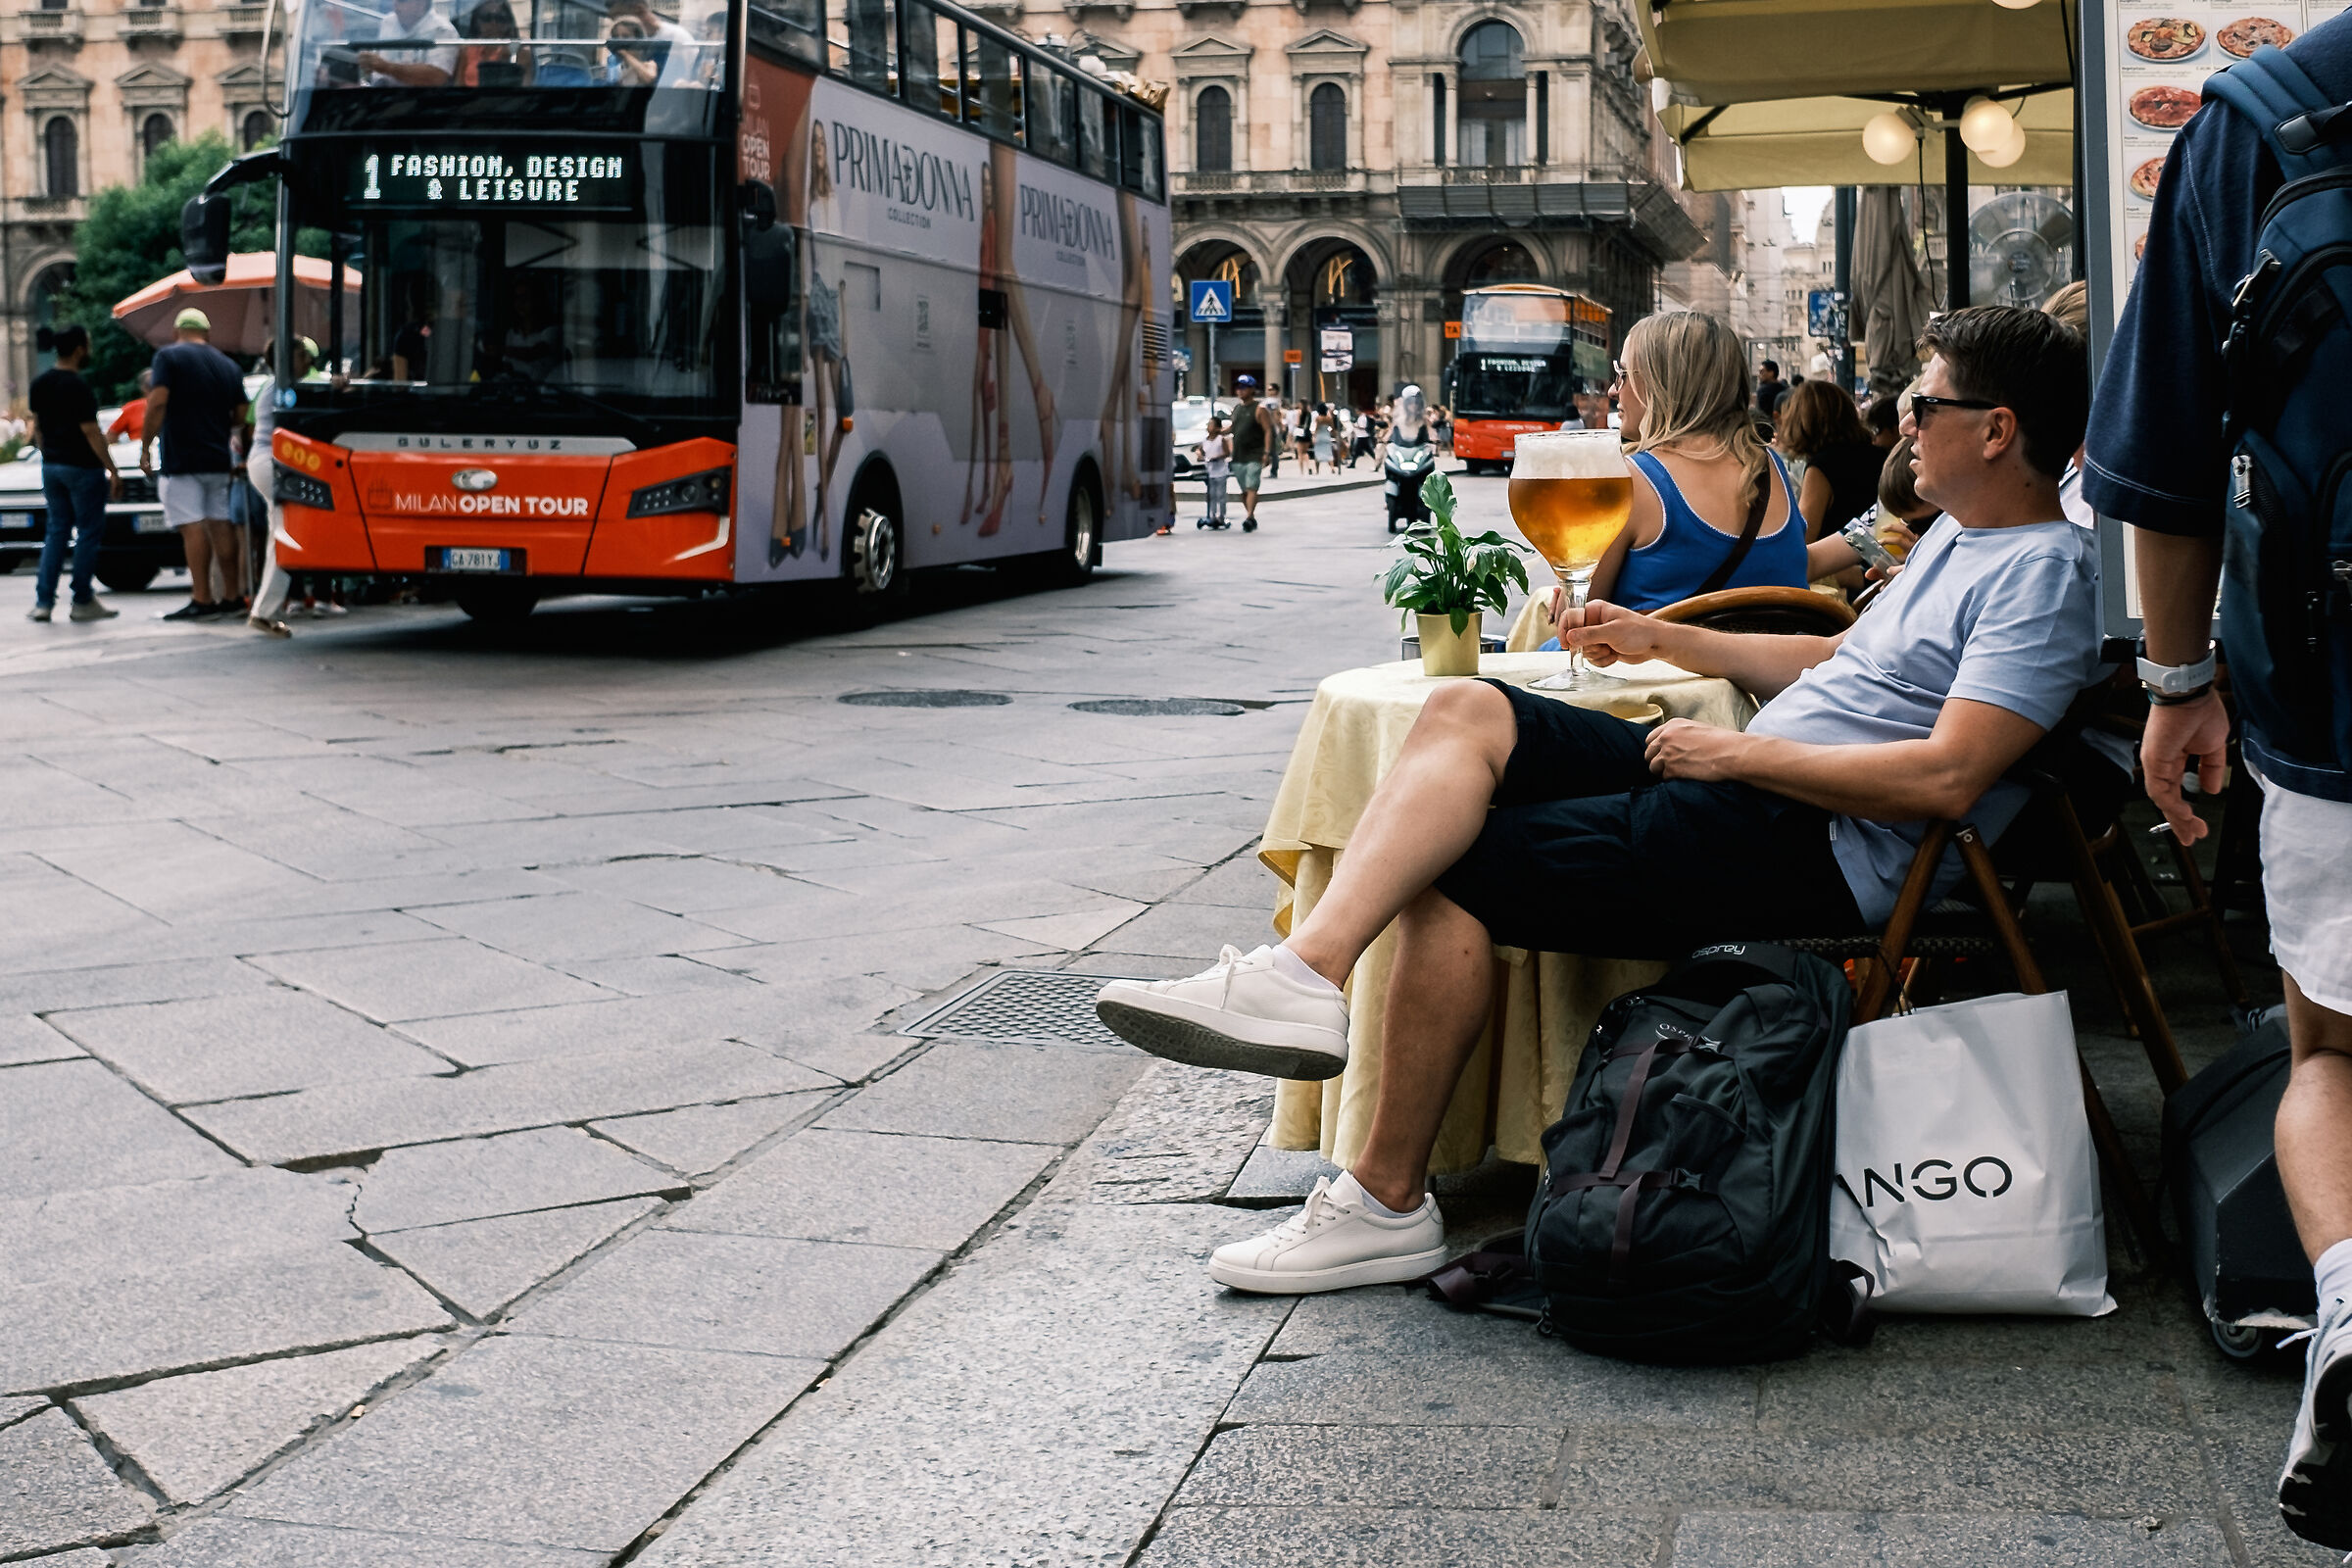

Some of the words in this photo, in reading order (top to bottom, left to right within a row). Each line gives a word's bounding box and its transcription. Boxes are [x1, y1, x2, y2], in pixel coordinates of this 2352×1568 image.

[742, 133, 770, 160] OPEN
[364, 154, 381, 199] 1
[391, 154, 514, 176] FASHION,
[526, 155, 622, 178] DESIGN
[742, 156, 770, 179] TOUR
[832, 121, 975, 222] PRIMADONNA
[427, 178, 442, 200] &
[459, 178, 579, 201] LEISURE
[888, 206, 932, 229] COLLECTION
[1019, 183, 1116, 262] PRIMADONNA
[395, 492, 457, 513] MILAN
[460, 494, 520, 514] OPEN
[525, 496, 589, 516] TOUR
[1691, 944, 1746, 958] osprey
